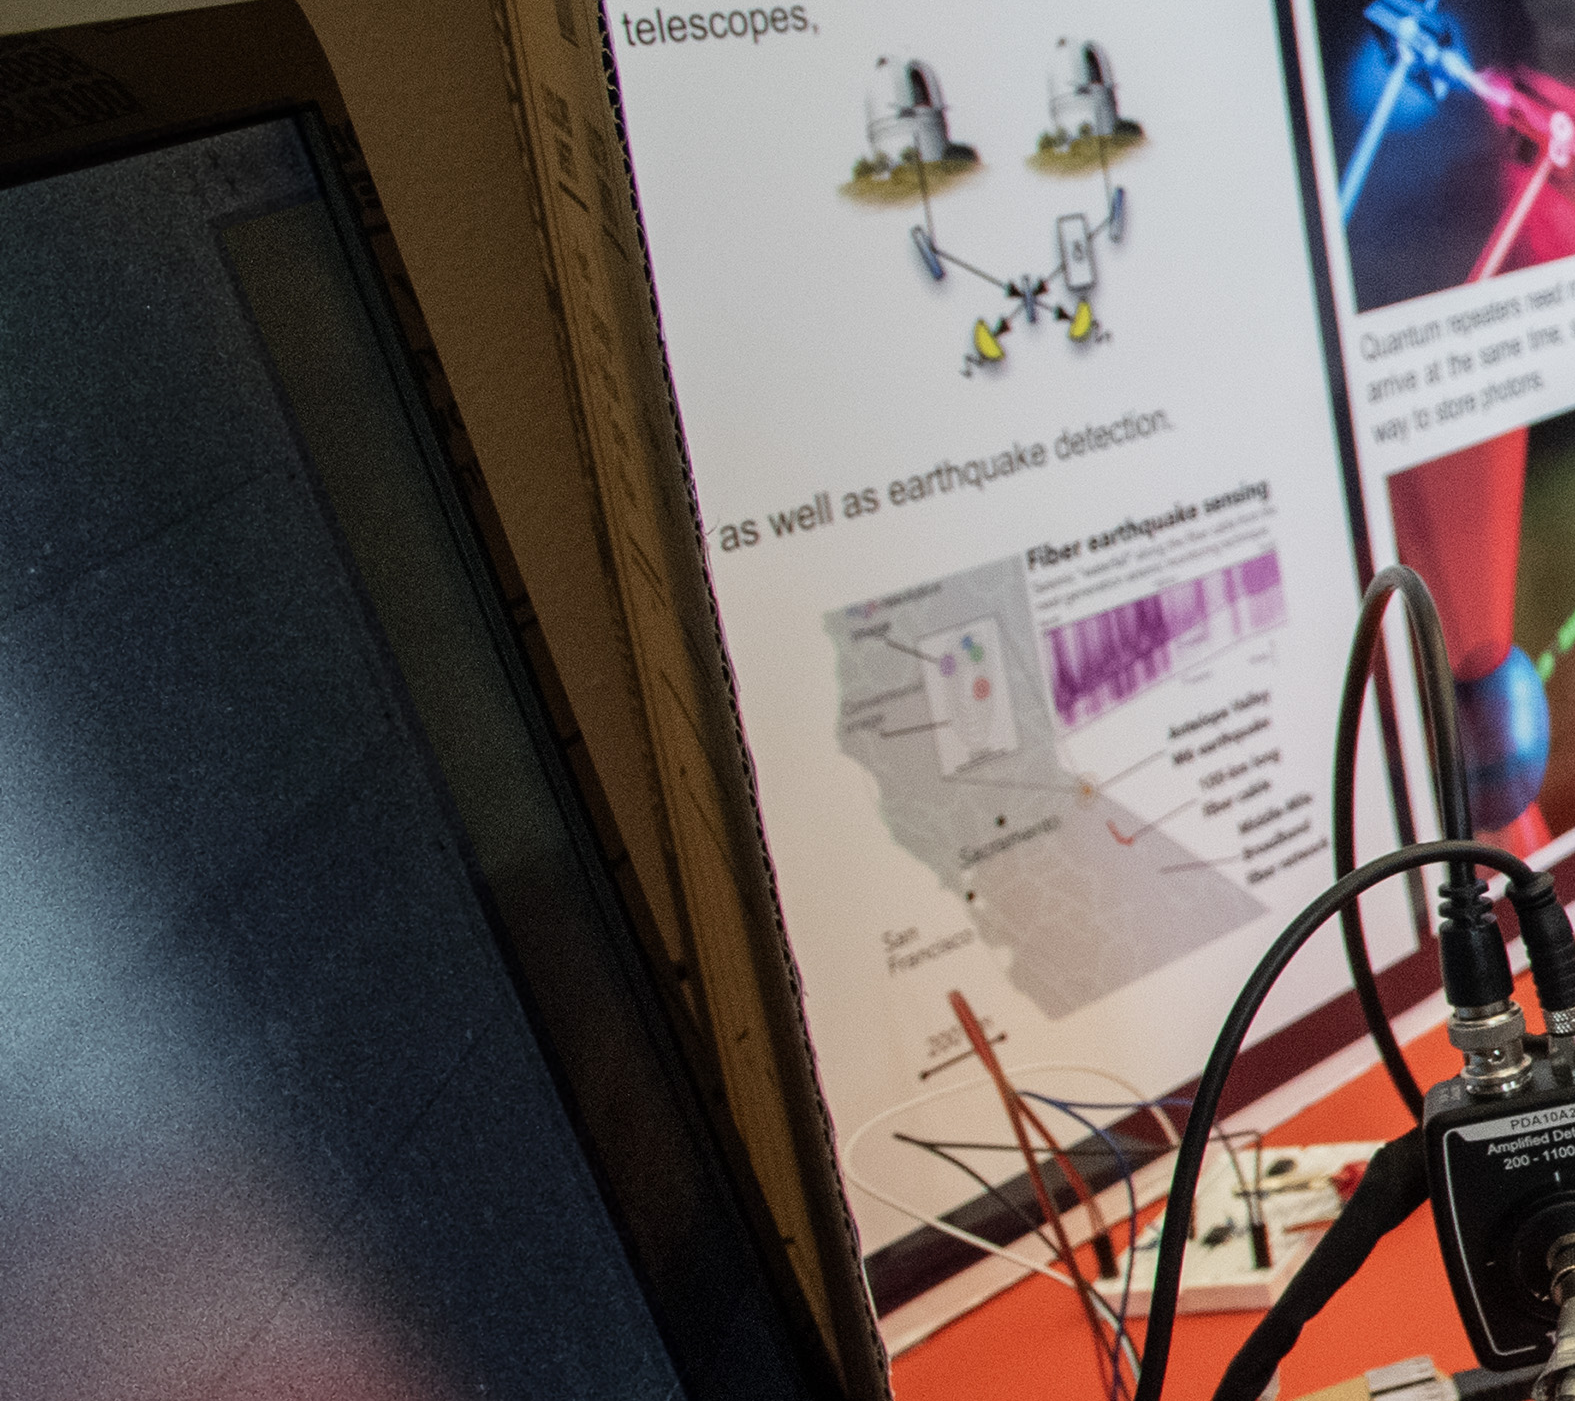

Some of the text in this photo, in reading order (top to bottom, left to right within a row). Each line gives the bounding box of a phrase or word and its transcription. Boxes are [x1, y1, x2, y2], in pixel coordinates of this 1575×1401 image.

[620, 4, 818, 47] telescopes,
[718, 409, 1175, 553] as well as earthquake detection.
[1024, 480, 1270, 571] Fiber earthquake sensing
[1487, 1133, 1551, 1157] Amplified
[1504, 1155, 1531, 1170] 200
[1541, 1143, 1575, 1163] 1100
